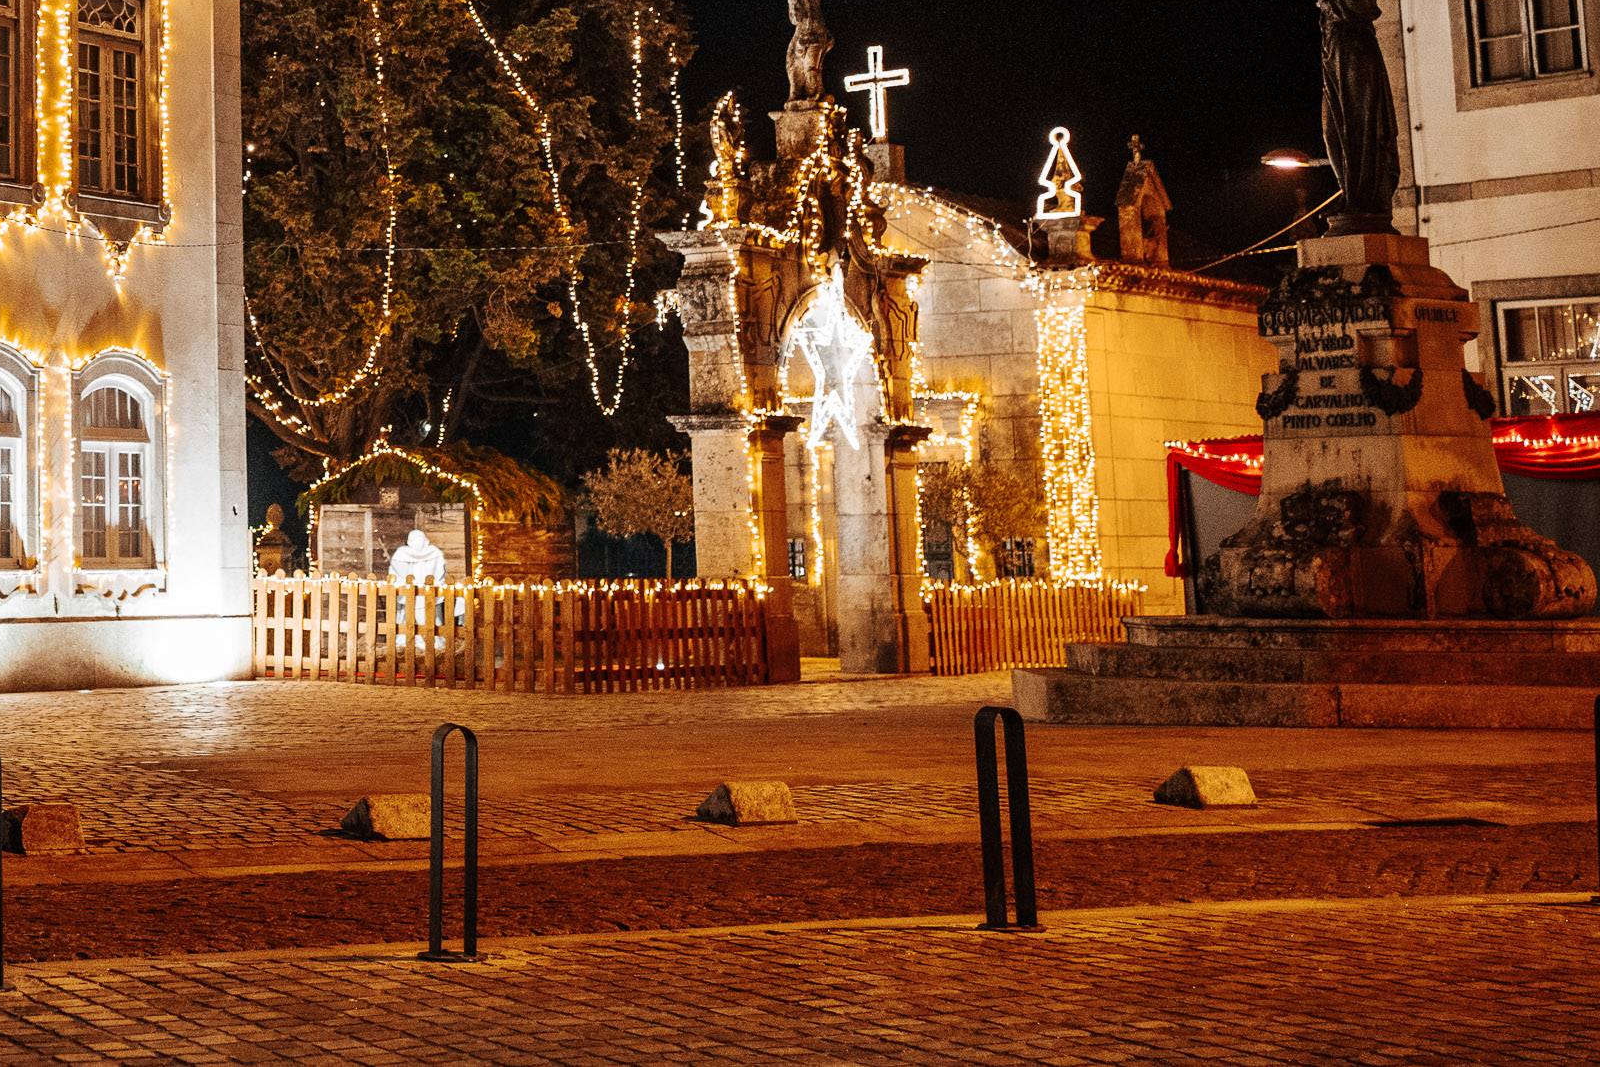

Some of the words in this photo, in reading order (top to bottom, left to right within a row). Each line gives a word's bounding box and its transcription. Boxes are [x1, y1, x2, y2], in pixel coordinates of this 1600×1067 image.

[1299, 334, 1354, 353] ALFREDO
[1320, 375, 1336, 389] DE
[1296, 394, 1363, 409] CARVALHO
[1282, 414, 1321, 429] PINTO
[1325, 412, 1376, 427] COELHO
